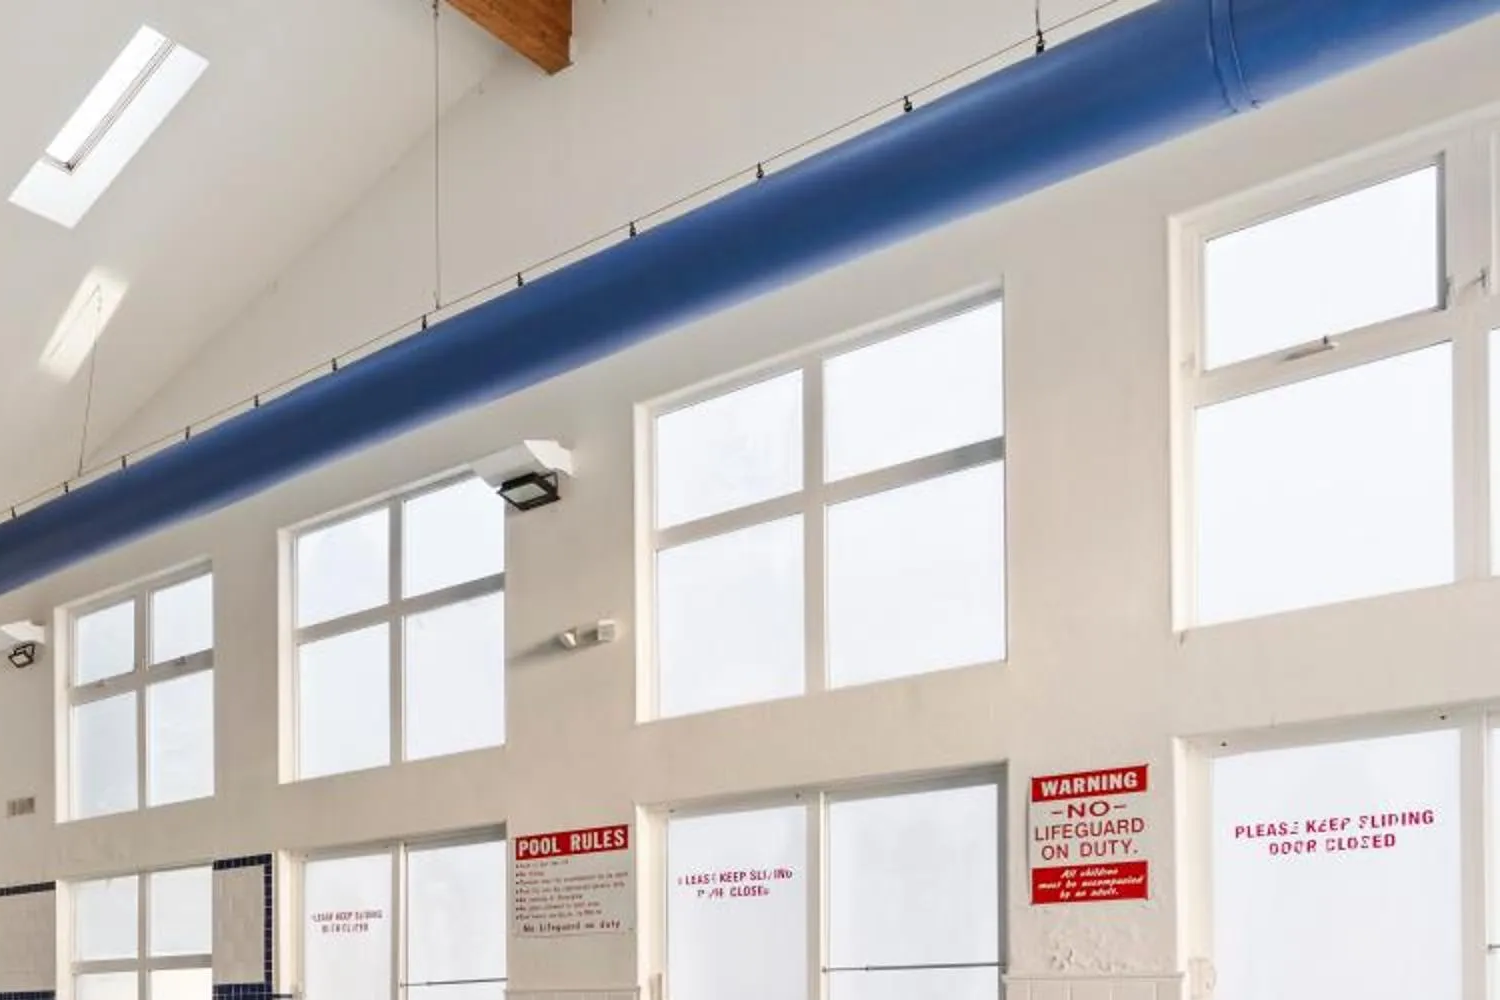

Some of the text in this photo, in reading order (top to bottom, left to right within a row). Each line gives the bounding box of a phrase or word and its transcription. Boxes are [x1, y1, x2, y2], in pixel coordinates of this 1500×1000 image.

[1041, 771, 1138, 797] WARNING
[1034, 817, 1145, 842] LIFEGUARD
[518, 829, 625, 857] POOL RULES
[1041, 839, 1139, 861] ON DUTY.
